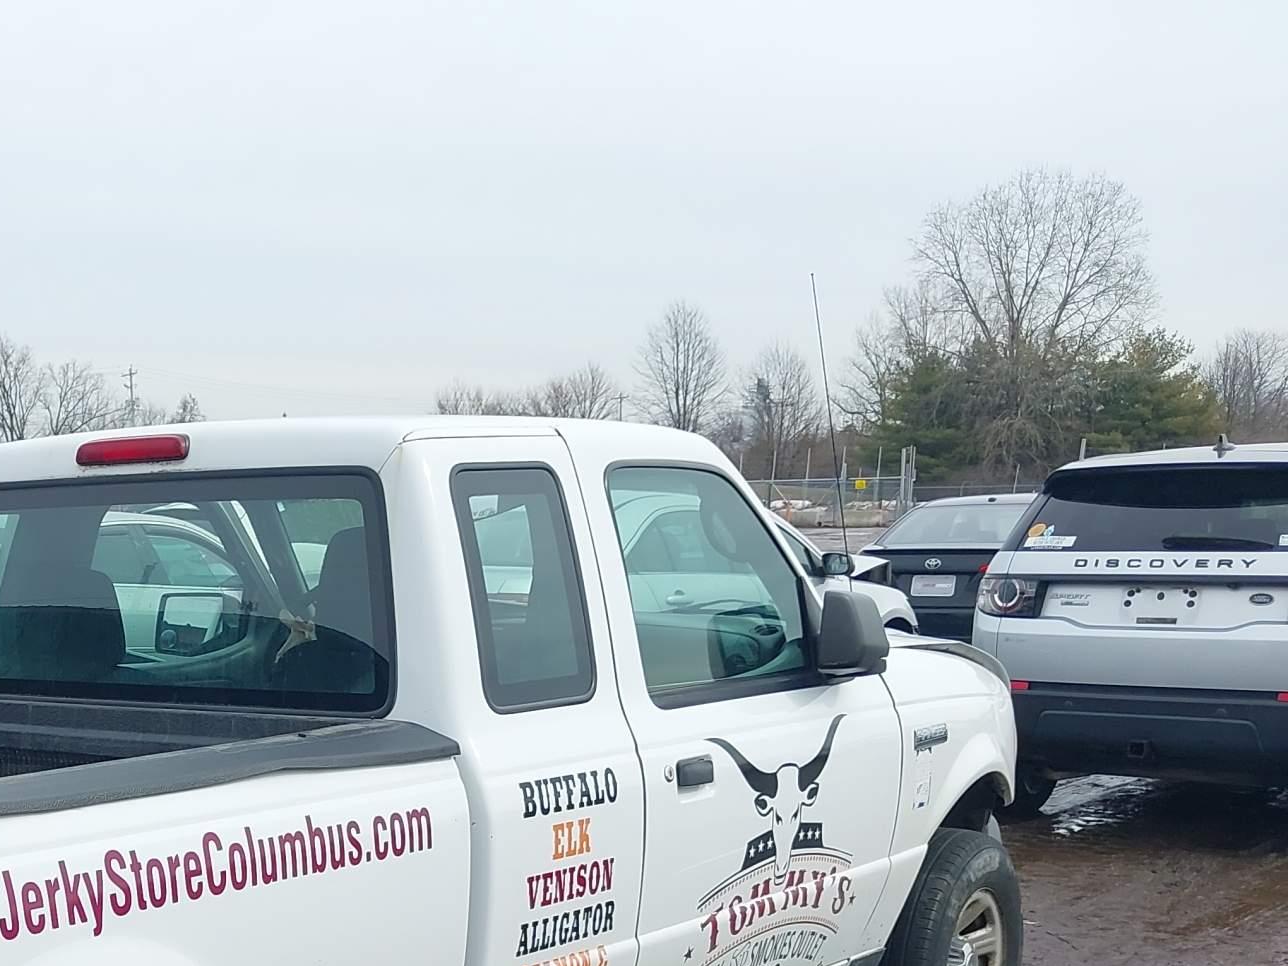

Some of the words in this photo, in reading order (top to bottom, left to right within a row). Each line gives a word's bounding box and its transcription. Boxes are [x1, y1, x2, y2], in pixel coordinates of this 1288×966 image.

[1074, 558, 1257, 569] DISCOVERY
[519, 767, 618, 818] BUFFALO
[552, 818, 591, 860] ELK
[527, 858, 614, 910] VENISON
[700, 866, 851, 953] TOMMY'S
[516, 901, 615, 957] ALLIGATOR
[790, 929, 827, 961] OUTLET
